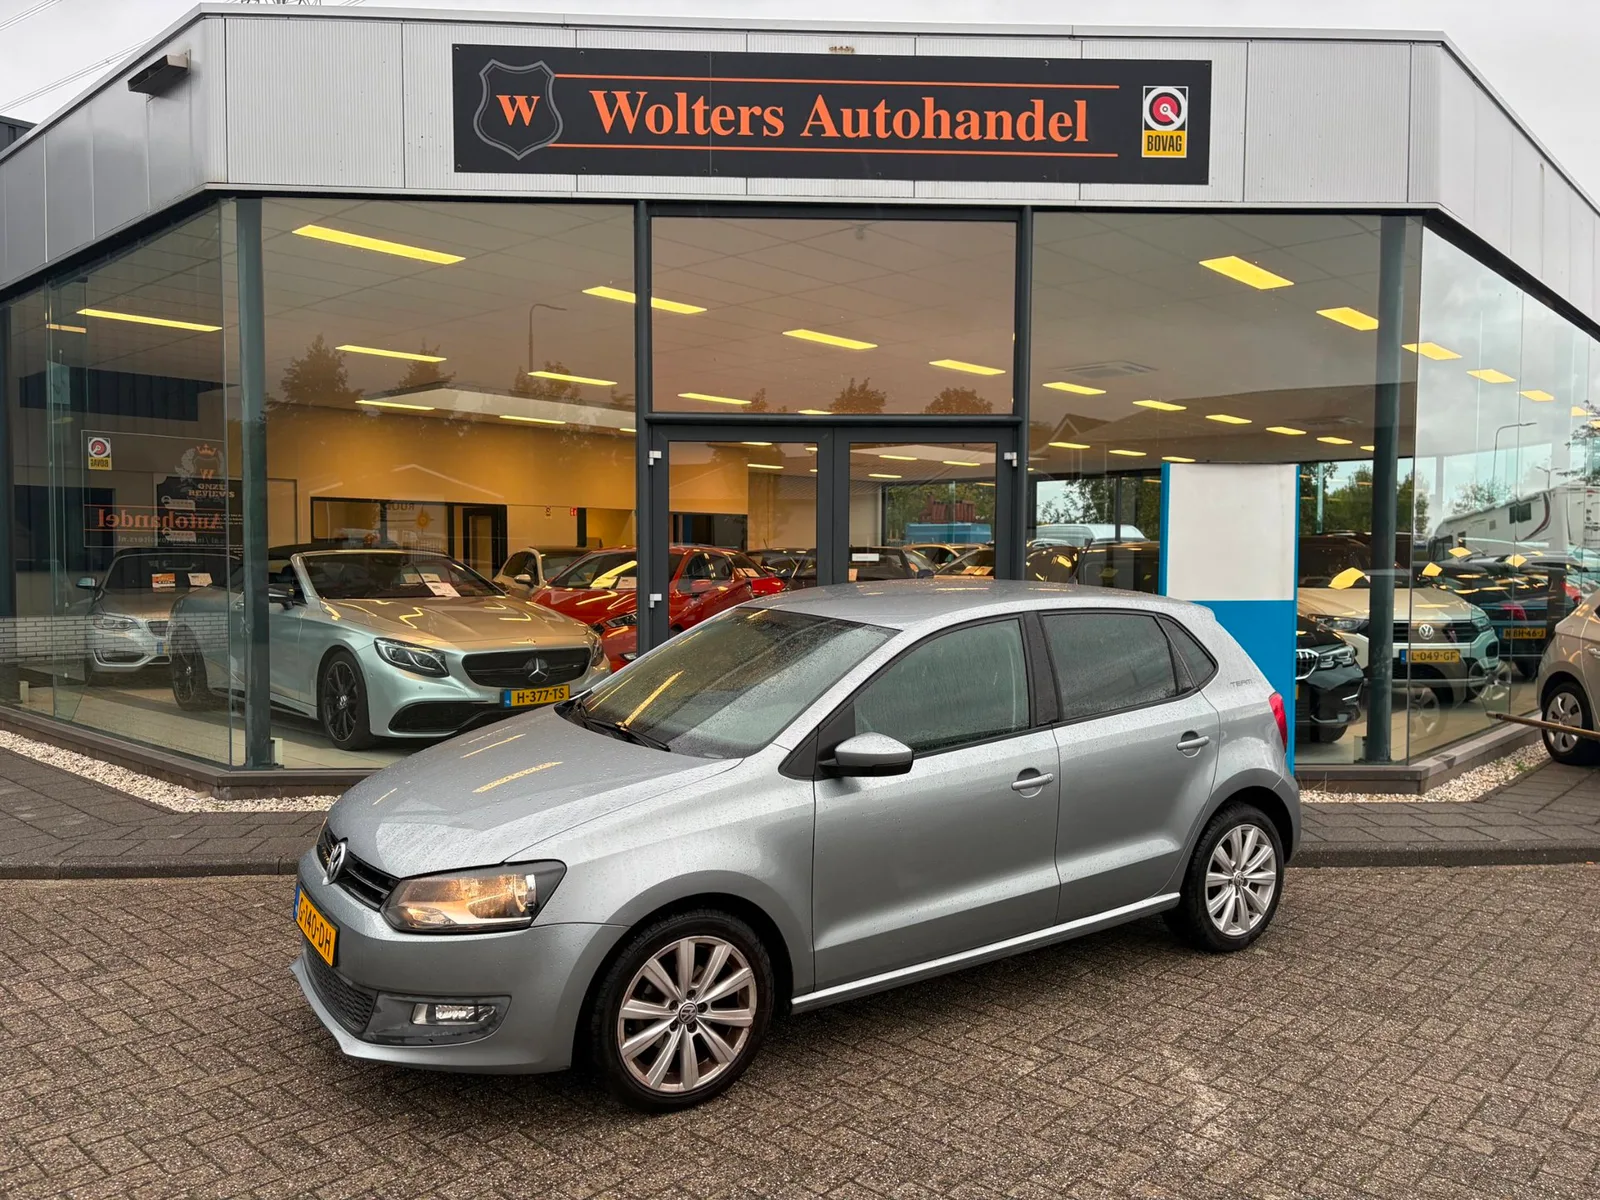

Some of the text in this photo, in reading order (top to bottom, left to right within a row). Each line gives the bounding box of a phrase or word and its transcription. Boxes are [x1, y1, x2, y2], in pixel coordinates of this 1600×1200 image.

[496, 94, 540, 126] W
[589, 90, 1089, 142] Wolters Autohandel
[1147, 135, 1182, 152] BOVAG
[1411, 651, 1456, 661] L-049-GF
[516, 687, 565, 704] H-377-TS
[298, 897, 332, 957] G-140-DH
